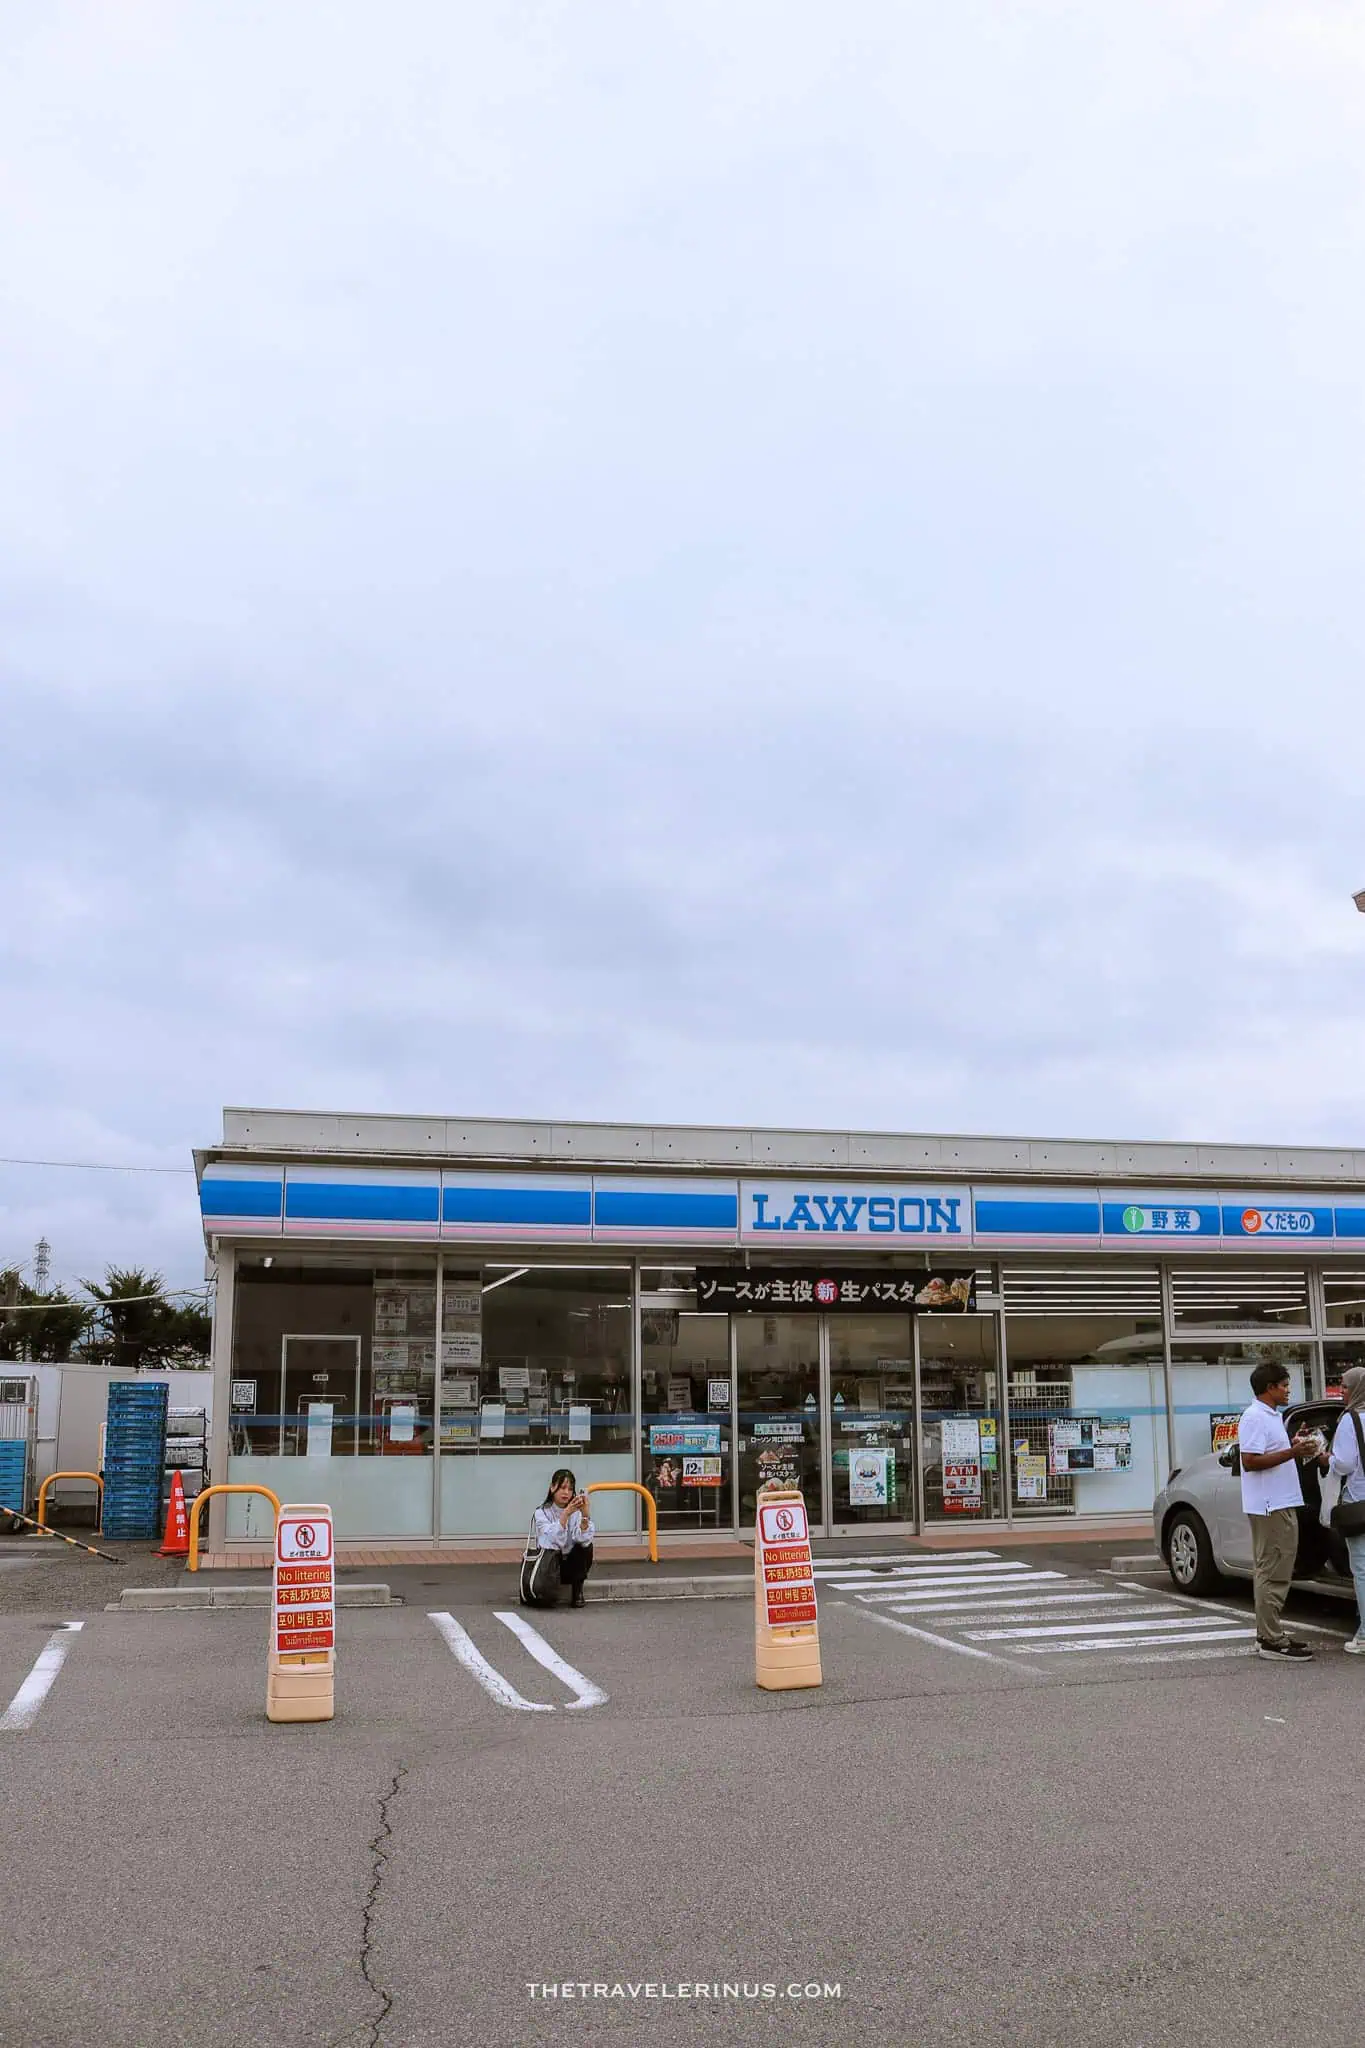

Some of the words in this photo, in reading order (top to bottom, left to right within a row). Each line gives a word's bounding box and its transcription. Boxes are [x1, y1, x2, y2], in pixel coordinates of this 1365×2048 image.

[752, 1194, 962, 1233] LAWSON
[1151, 1210, 1192, 1230] 野菜
[1264, 1213, 1312, 1231] くだもの
[865, 1432, 878, 1442] 24
[949, 1466, 974, 1476] ATM
[765, 1552, 778, 1562] No
[780, 1550, 810, 1562] littering
[279, 1571, 292, 1582] No
[294, 1568, 331, 1582] littering
[767, 1566, 811, 1581] 不乱扔垃圾
[279, 1587, 331, 1603] 不乱扔垃圾
[768, 1590, 783, 1603] 포이
[784, 1589, 799, 1602] 버림
[801, 1587, 814, 1602] 금지
[278, 1614, 296, 1628] 포이
[297, 1612, 314, 1627] 버림
[317, 1611, 332, 1626] 금지
